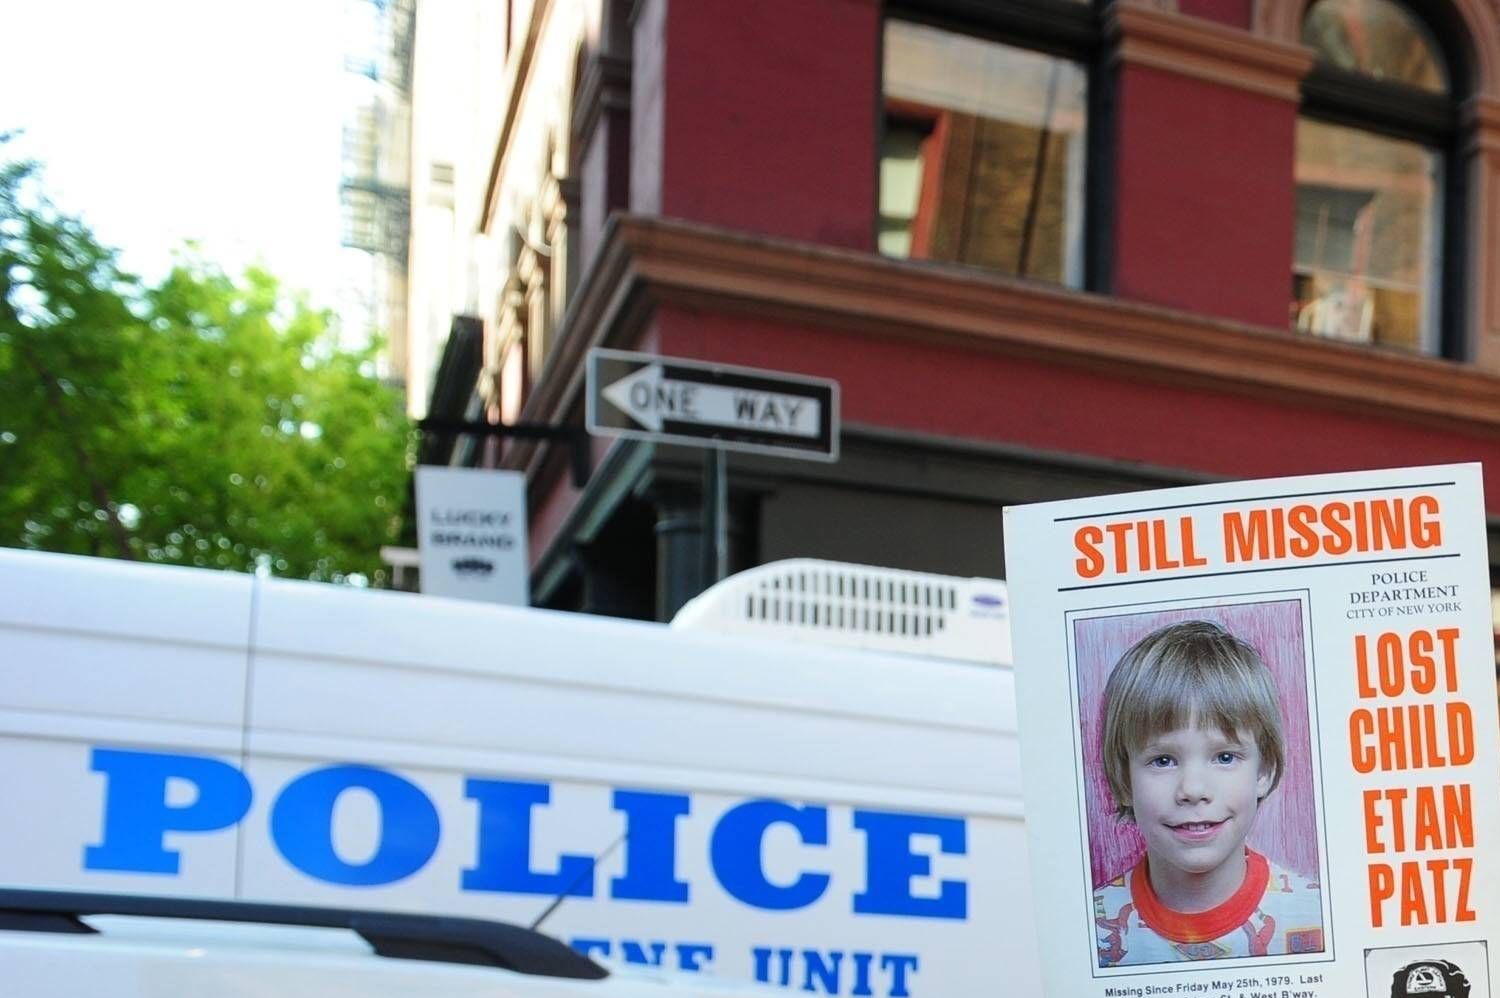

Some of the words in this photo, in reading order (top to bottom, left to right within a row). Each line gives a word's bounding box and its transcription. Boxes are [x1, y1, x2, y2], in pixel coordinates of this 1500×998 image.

[629, 380, 698, 414] ONE
[733, 395, 804, 426] WAY
[1073, 517, 1207, 579] STILL
[1223, 496, 1442, 563] MISSING
[1350, 585, 1459, 604] DEPARTMENT
[1371, 570, 1428, 585] POLICE
[1346, 608, 1375, 619] CITY
[1378, 606, 1394, 617] OF
[1396, 604, 1424, 616] NEW
[1428, 602, 1462, 613] YORK
[1355, 628, 1461, 699] LOST
[1349, 702, 1475, 775] CHILD
[81, 748, 969, 920] POLICE
[1363, 784, 1475, 854] ETAN
[1367, 858, 1477, 928] PATZ
[752, 947, 918, 997] UNIT
[1105, 987, 1143, 997] Missing
[1145, 985, 1174, 995] Since
[1176, 982, 1208, 992] Friday
[1212, 980, 1233, 991] May
[1236, 977, 1263, 988] 25th,
[1265, 976, 1294, 986] 1979.
[1300, 974, 1323, 984] Last
